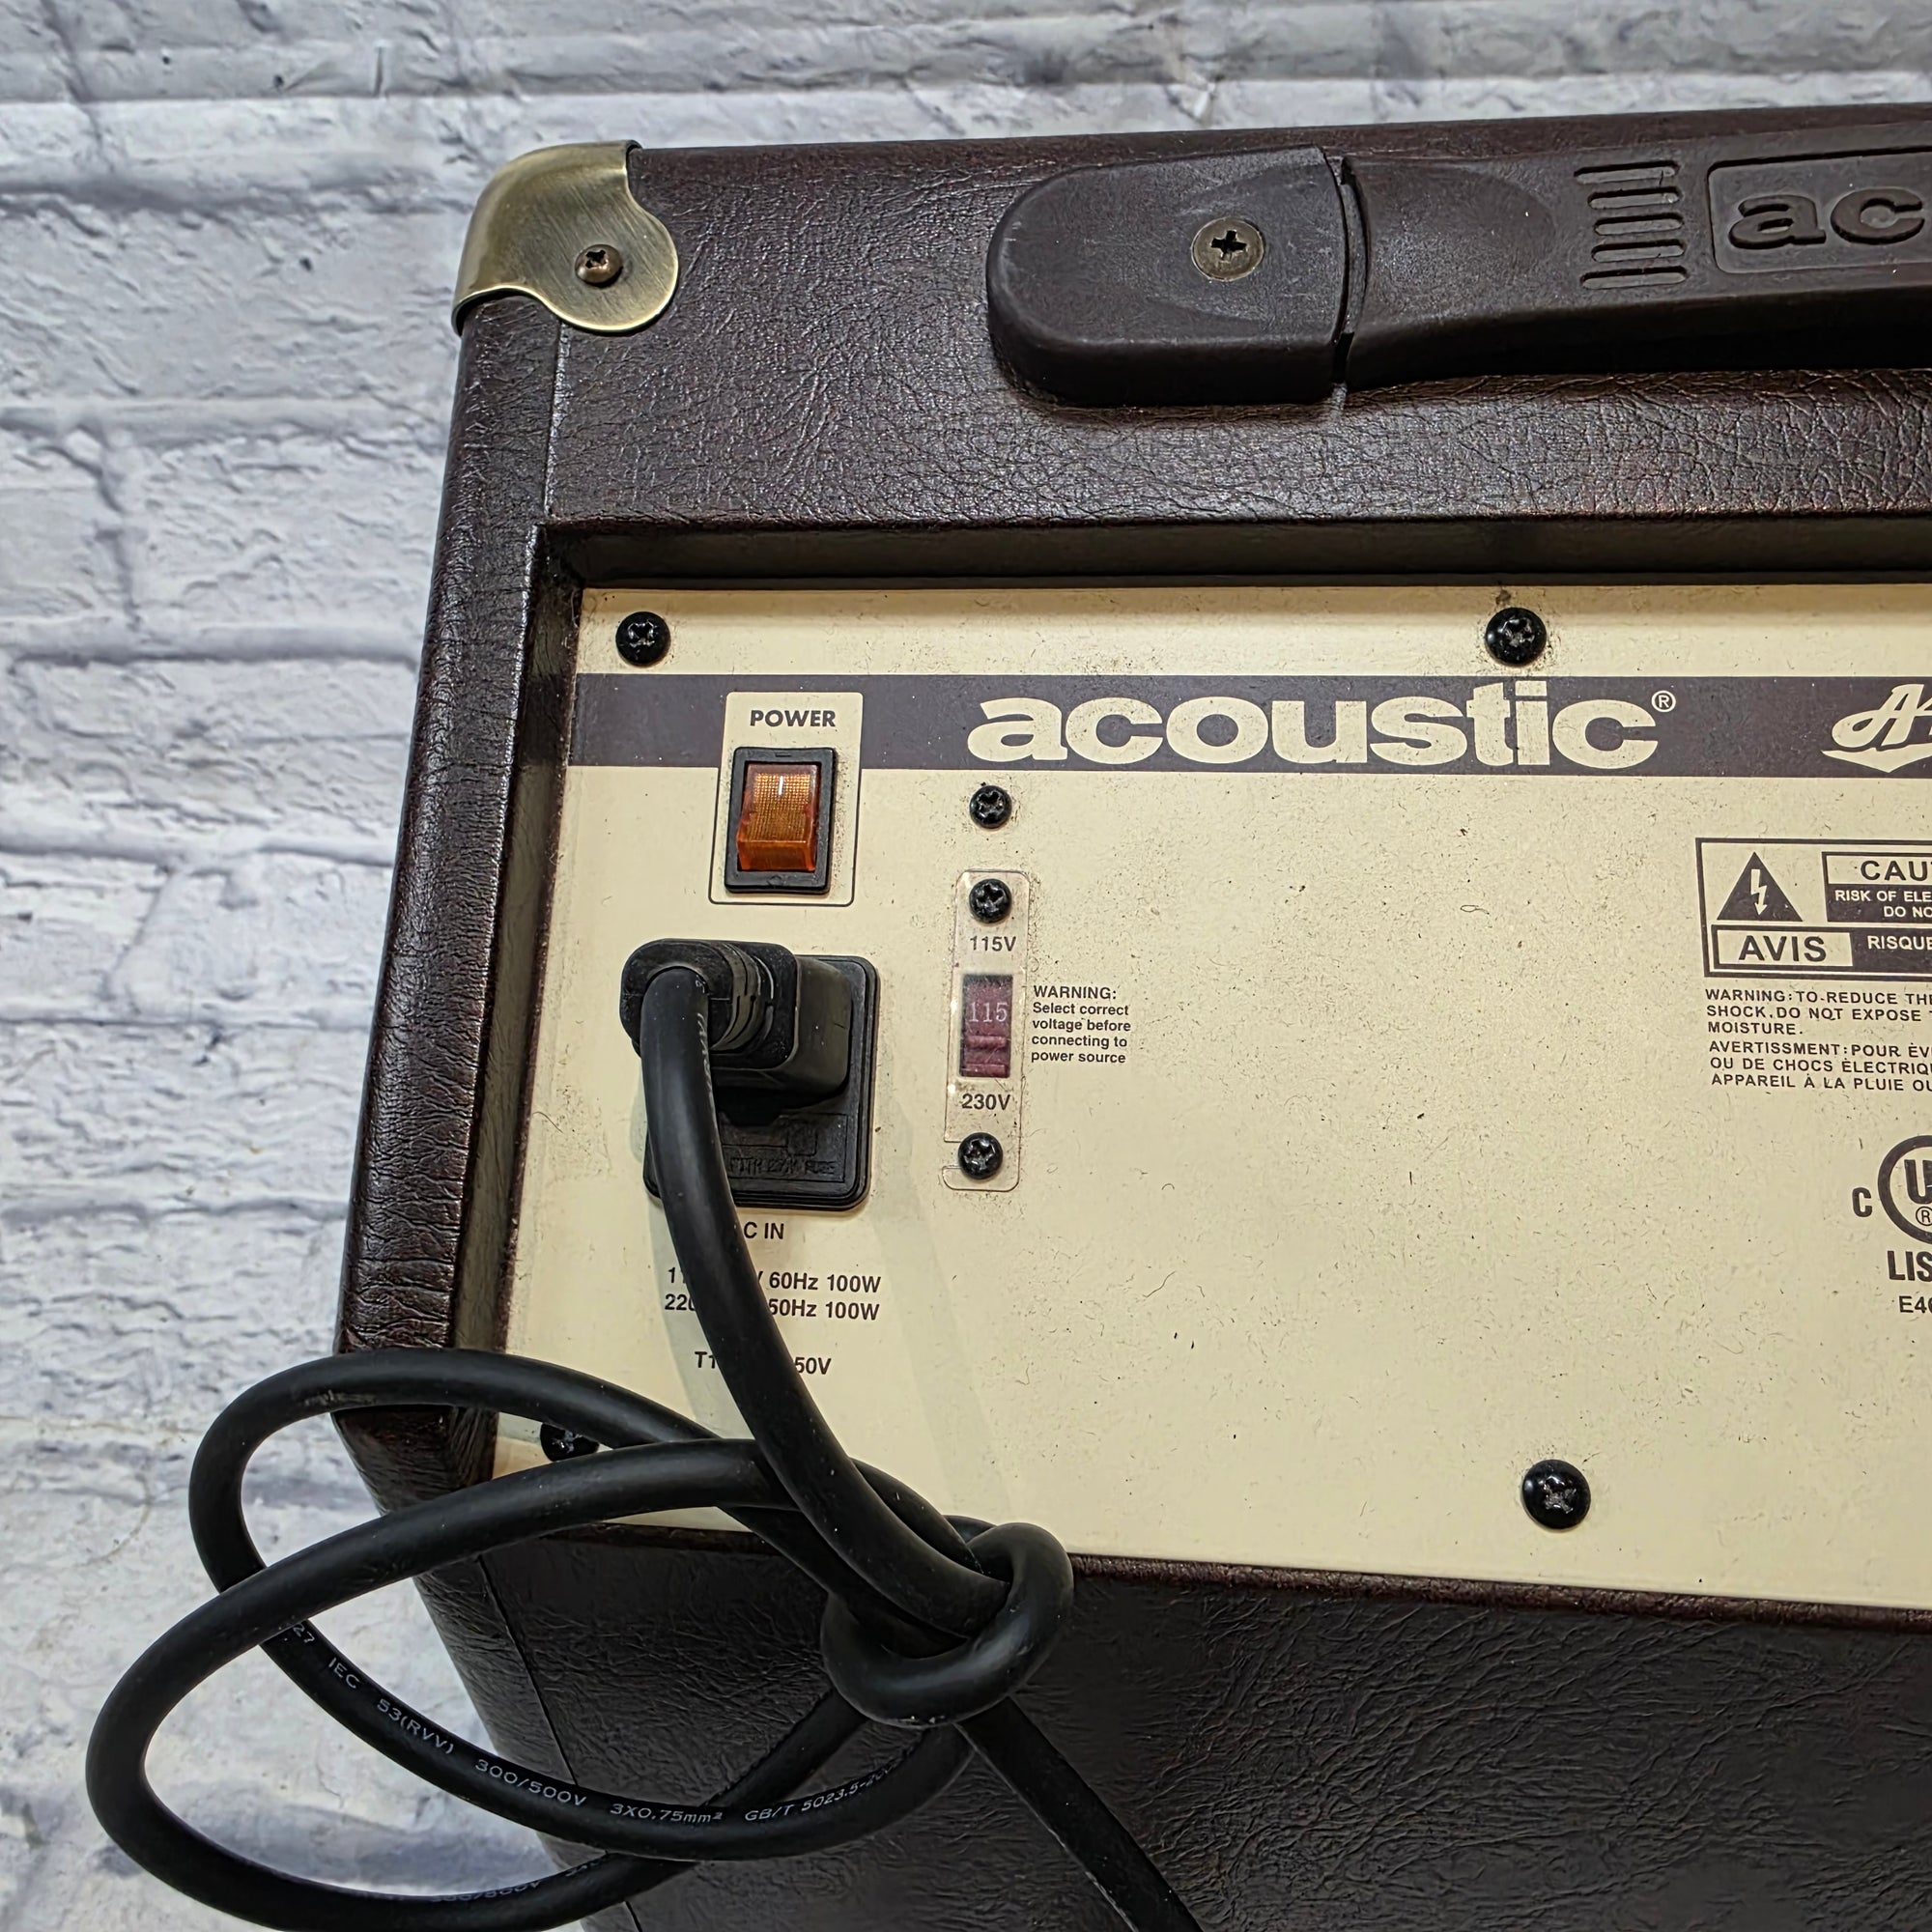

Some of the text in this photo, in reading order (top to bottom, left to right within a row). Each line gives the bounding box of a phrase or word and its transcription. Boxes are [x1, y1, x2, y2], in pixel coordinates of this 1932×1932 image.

[1728, 186, 1926, 250] ac
[750, 709, 837, 727] POWER
[1861, 860, 1932, 882] CAU
[1835, 890, 1932, 903] RISK OF ELE
[1884, 906, 1932, 919] DO NO
[970, 935, 1016, 952] 115V
[1738, 935, 1827, 962] AVIS
[1034, 984, 1117, 1000] WARNING:
[1827, 991, 1899, 1005] REDUCE
[969, 1002, 1009, 1023] 115
[1033, 1001, 1129, 1016] Select correct
[1852, 1009, 1922, 1022] EXPOSE
[1032, 1017, 1131, 1034] voltage before
[1708, 1021, 1804, 1036] MOISTURE.
[1032, 1035, 1128, 1050] connecting to
[1031, 1051, 1126, 1064] power source
[1710, 1057, 1734, 1069] OU
[1742, 1058, 1766, 1070] DE
[1773, 1059, 1833, 1072] CHOCS
[1711, 1073, 1796, 1088] APPAREIL
[1823, 1076, 1846, 1090] LA
[1854, 1077, 1905, 1092] PLUIE
[961, 1094, 1010, 1111] 230V
[743, 1221, 784, 1239] C IN
[1887, 1250, 1932, 1283] LIS
[769, 1271, 819, 1291] 60Hz
[827, 1274, 882, 1293] 100W
[769, 1298, 817, 1318] 50Hz
[825, 1301, 880, 1321] 100W
[794, 1357, 832, 1376] 50V
[327, 1657, 361, 1690] IEC
[378, 1698, 454, 1754] 53(RVV)
[475, 1759, 587, 1806] 300/500V
[745, 1804, 794, 1822] GB/T
